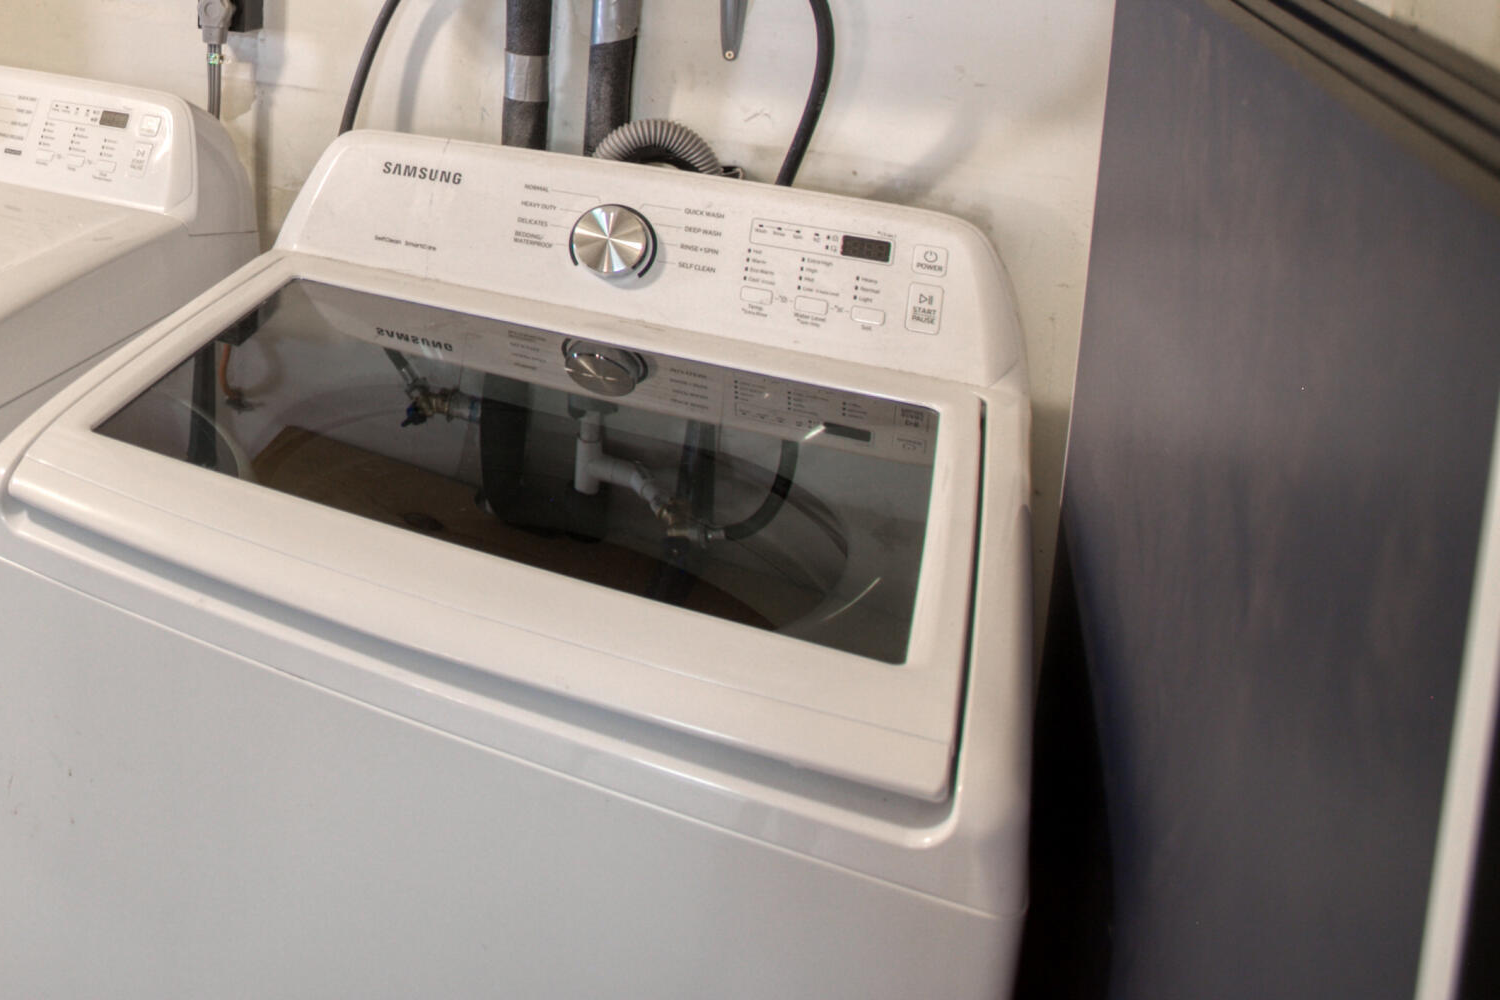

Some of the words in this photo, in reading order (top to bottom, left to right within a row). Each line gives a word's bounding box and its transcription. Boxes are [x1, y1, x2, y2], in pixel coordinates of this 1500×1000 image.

[382, 161, 463, 186] SAMSUNG
[524, 183, 549, 193] NORMAL
[520, 200, 541, 209] HEAVY
[541, 203, 557, 211] DUTY
[684, 207, 704, 216] QUICK
[705, 211, 725, 219] WASH
[517, 216, 549, 227] DELICATES
[514, 230, 544, 240] BEDDING/
[684, 225, 701, 234] DEEP
[702, 229, 722, 237] WASH
[513, 237, 553, 249] WATERPROOF
[680, 243, 699, 252] RINSE
[703, 247, 719, 255] SPIN
[678, 261, 694, 270] SELF
[694, 264, 716, 273] CLEAN
[916, 262, 943, 272] POWER
[912, 306, 937, 315] START
[911, 314, 936, 325] PAUSE
